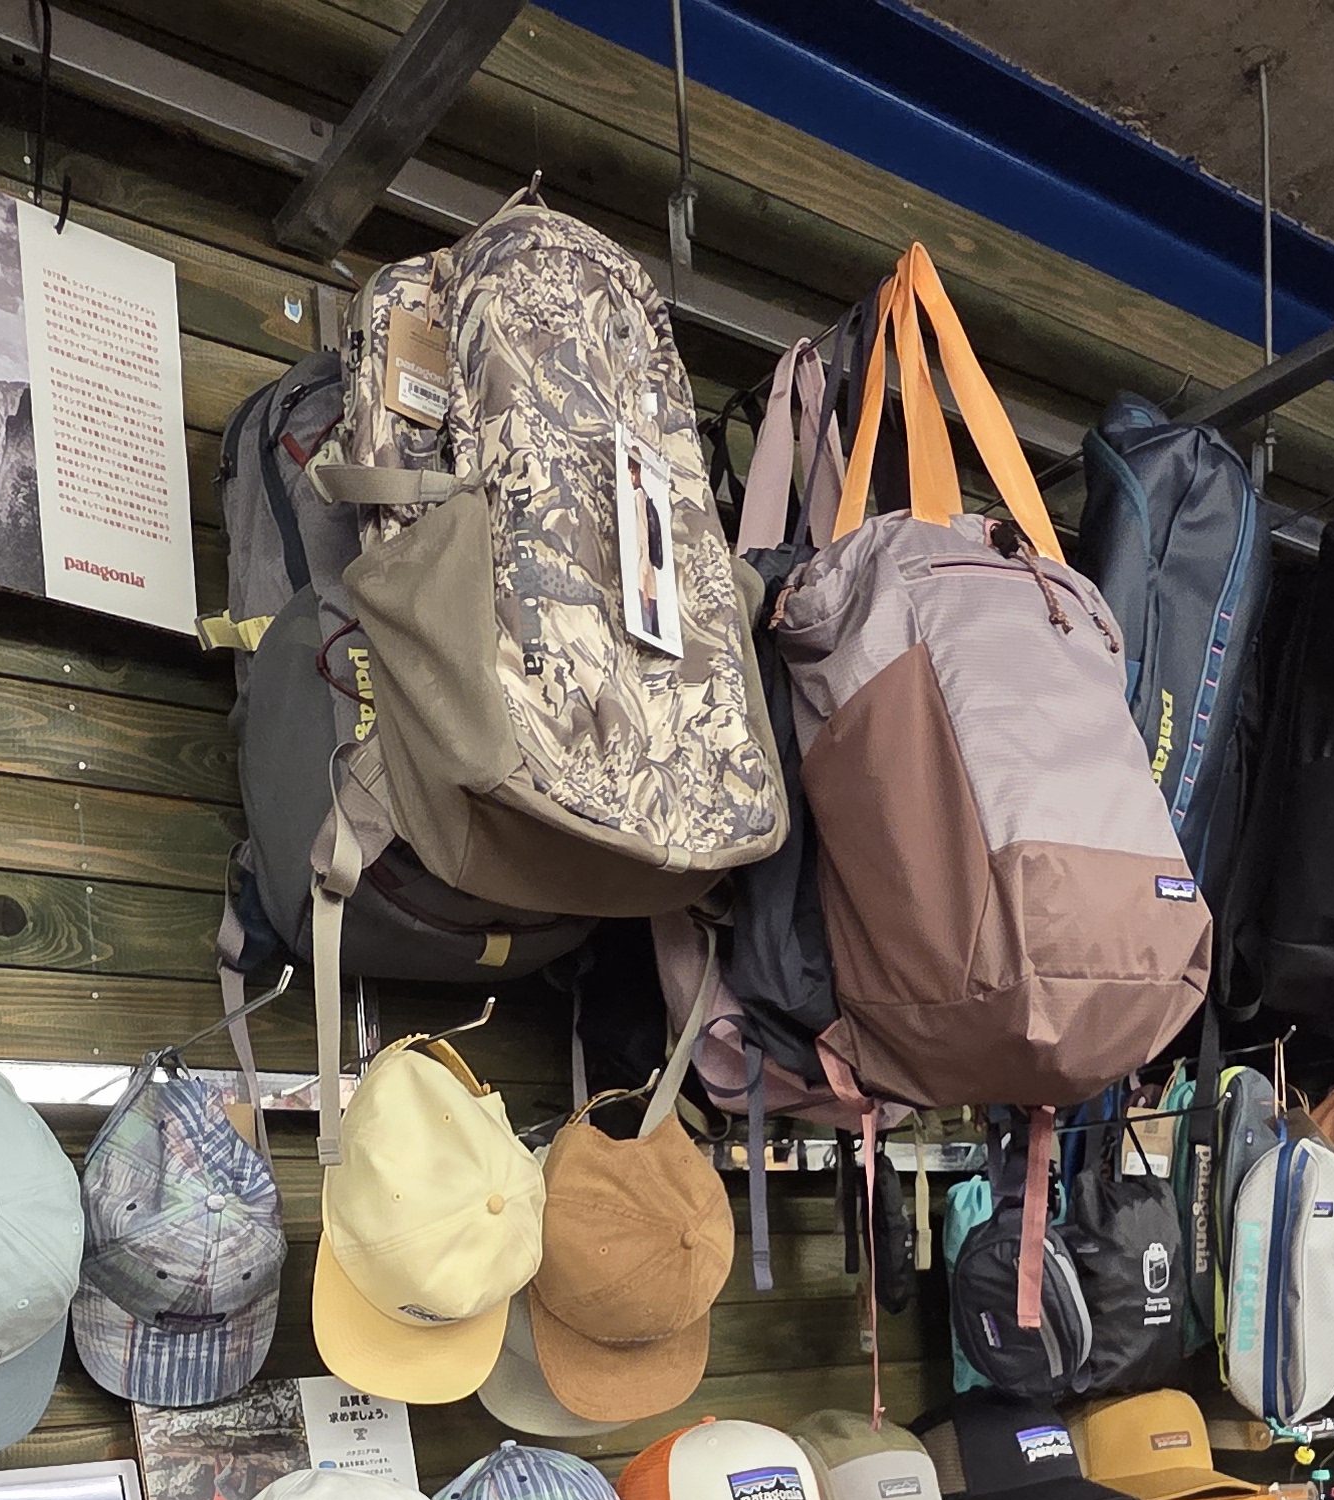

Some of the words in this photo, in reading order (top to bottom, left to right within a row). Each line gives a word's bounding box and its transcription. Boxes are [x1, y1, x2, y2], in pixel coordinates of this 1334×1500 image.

[63, 555, 146, 590] patagonia
[1193, 1144, 1212, 1274] patagonia
[340, 1395, 370, 1407] 品質を
[329, 1409, 388, 1423] 求めましょう。
